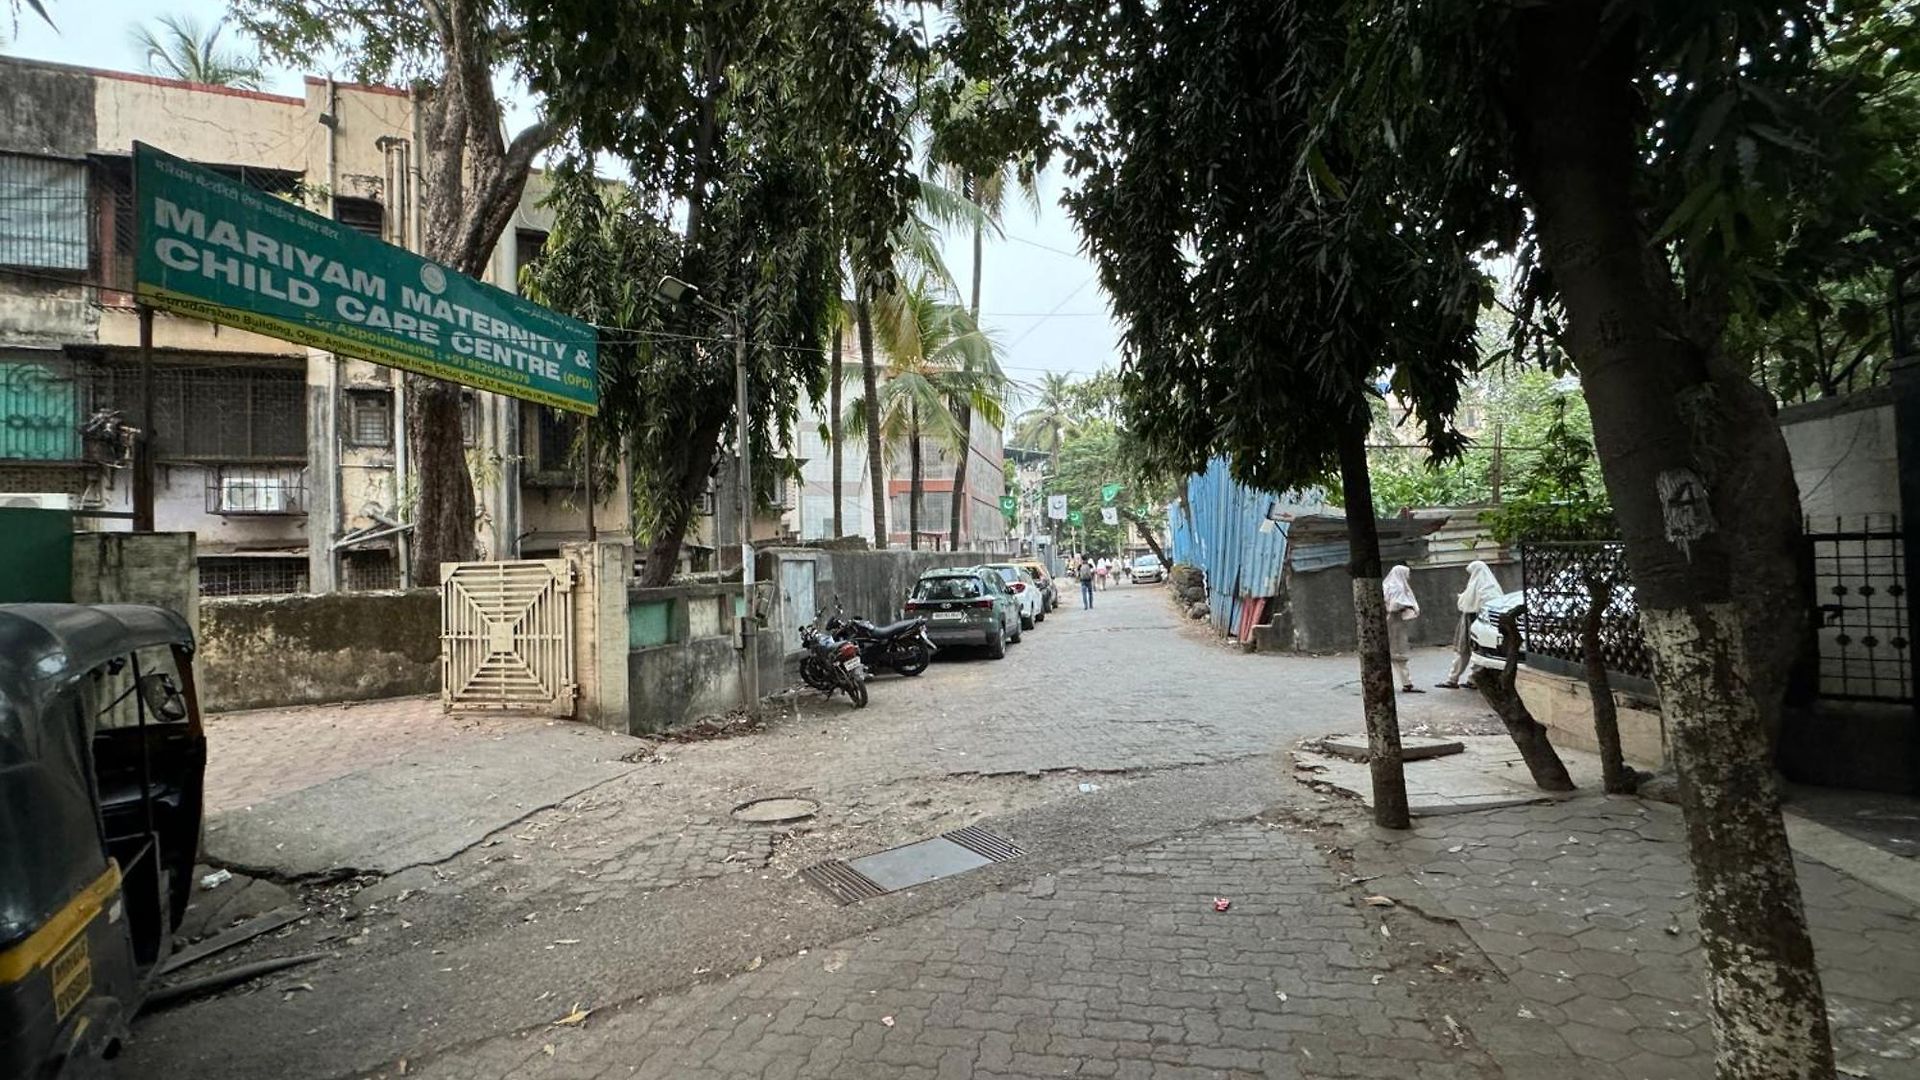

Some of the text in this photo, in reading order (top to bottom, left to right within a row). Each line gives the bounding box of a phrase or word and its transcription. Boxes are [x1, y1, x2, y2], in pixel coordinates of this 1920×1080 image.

[154, 195, 384, 301] MARIYAM
[402, 286, 566, 360] MATERNITY
[575, 346, 591, 370] &
[154, 232, 592, 391] CHILD CARE CENTRE (OPD)
[304, 311, 332, 330] For
[337, 322, 434, 359] Appointments
